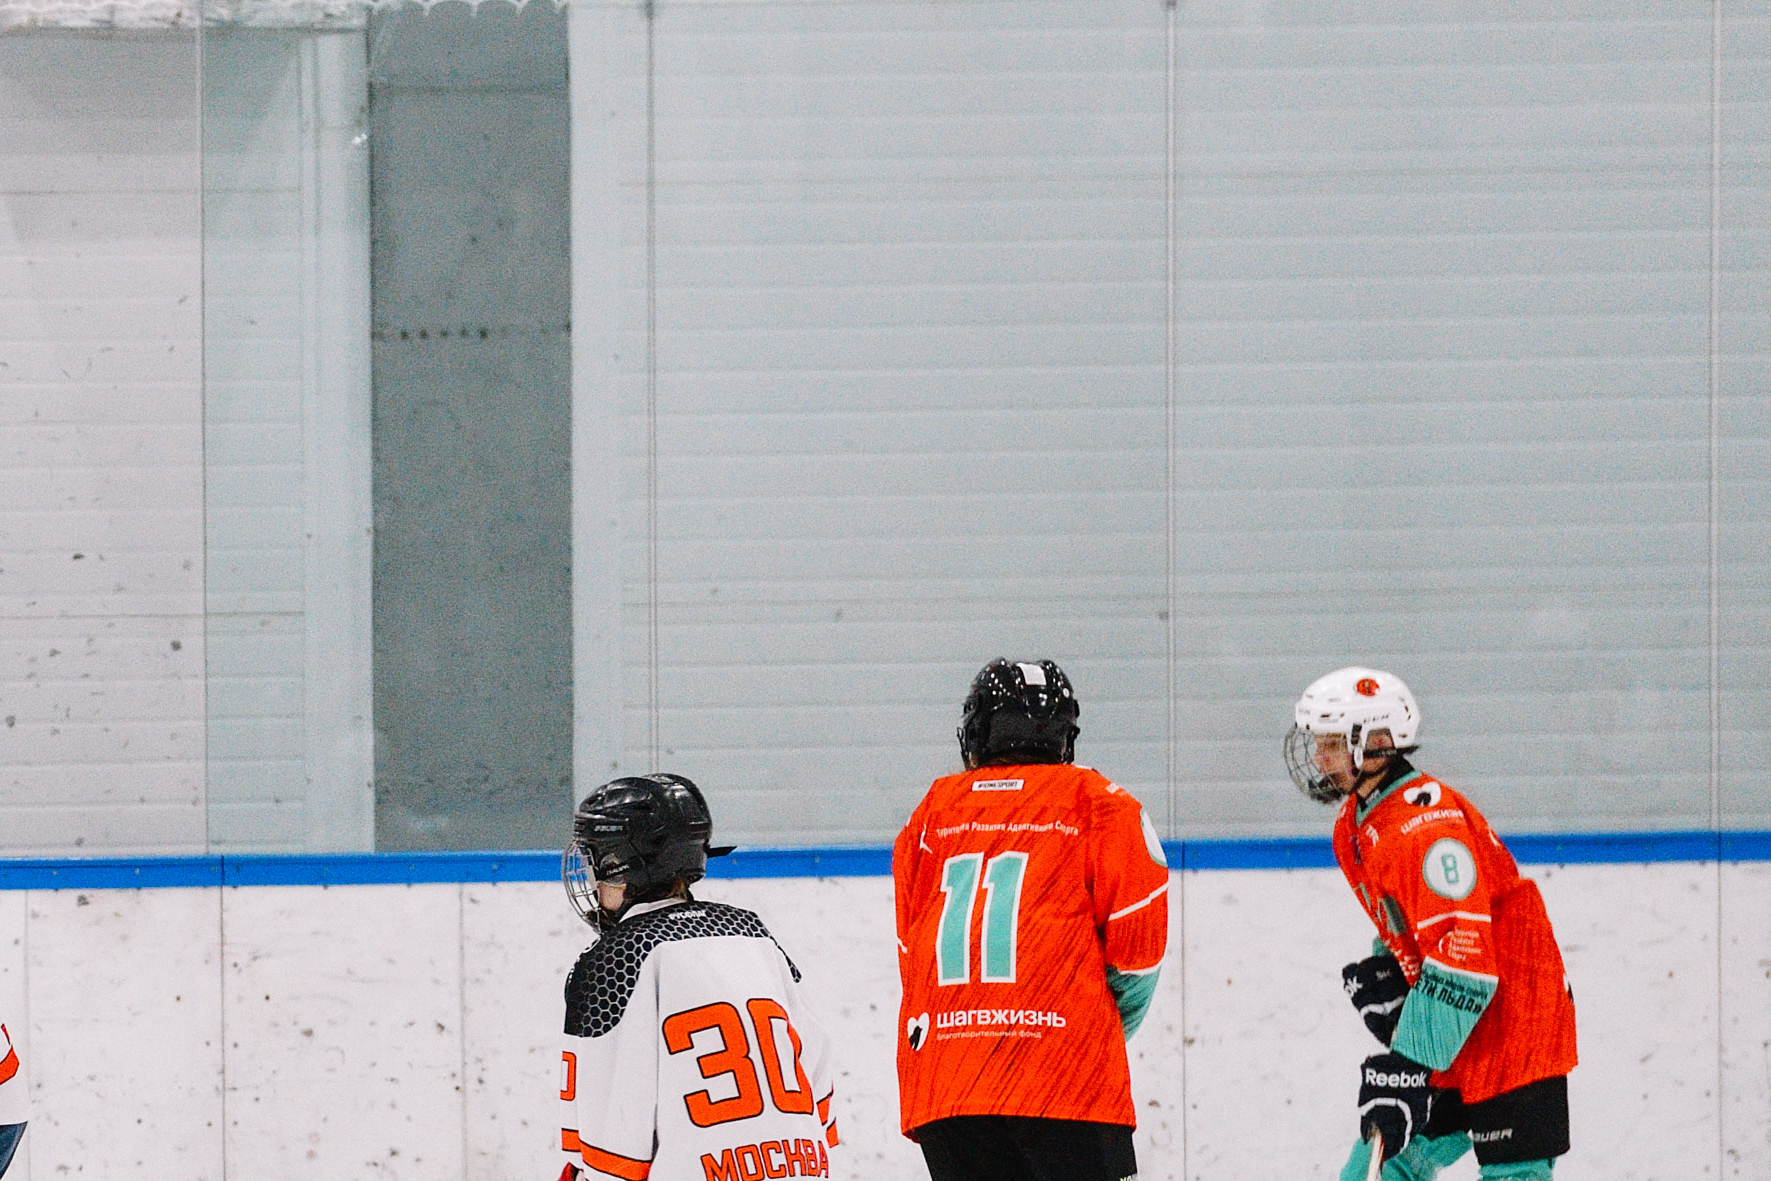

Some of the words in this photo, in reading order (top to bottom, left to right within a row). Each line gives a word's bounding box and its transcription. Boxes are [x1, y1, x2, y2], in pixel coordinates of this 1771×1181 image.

[935, 850, 1029, 987] 11
[662, 997, 814, 1128] 30
[1365, 1067, 1427, 1088] Reebok
